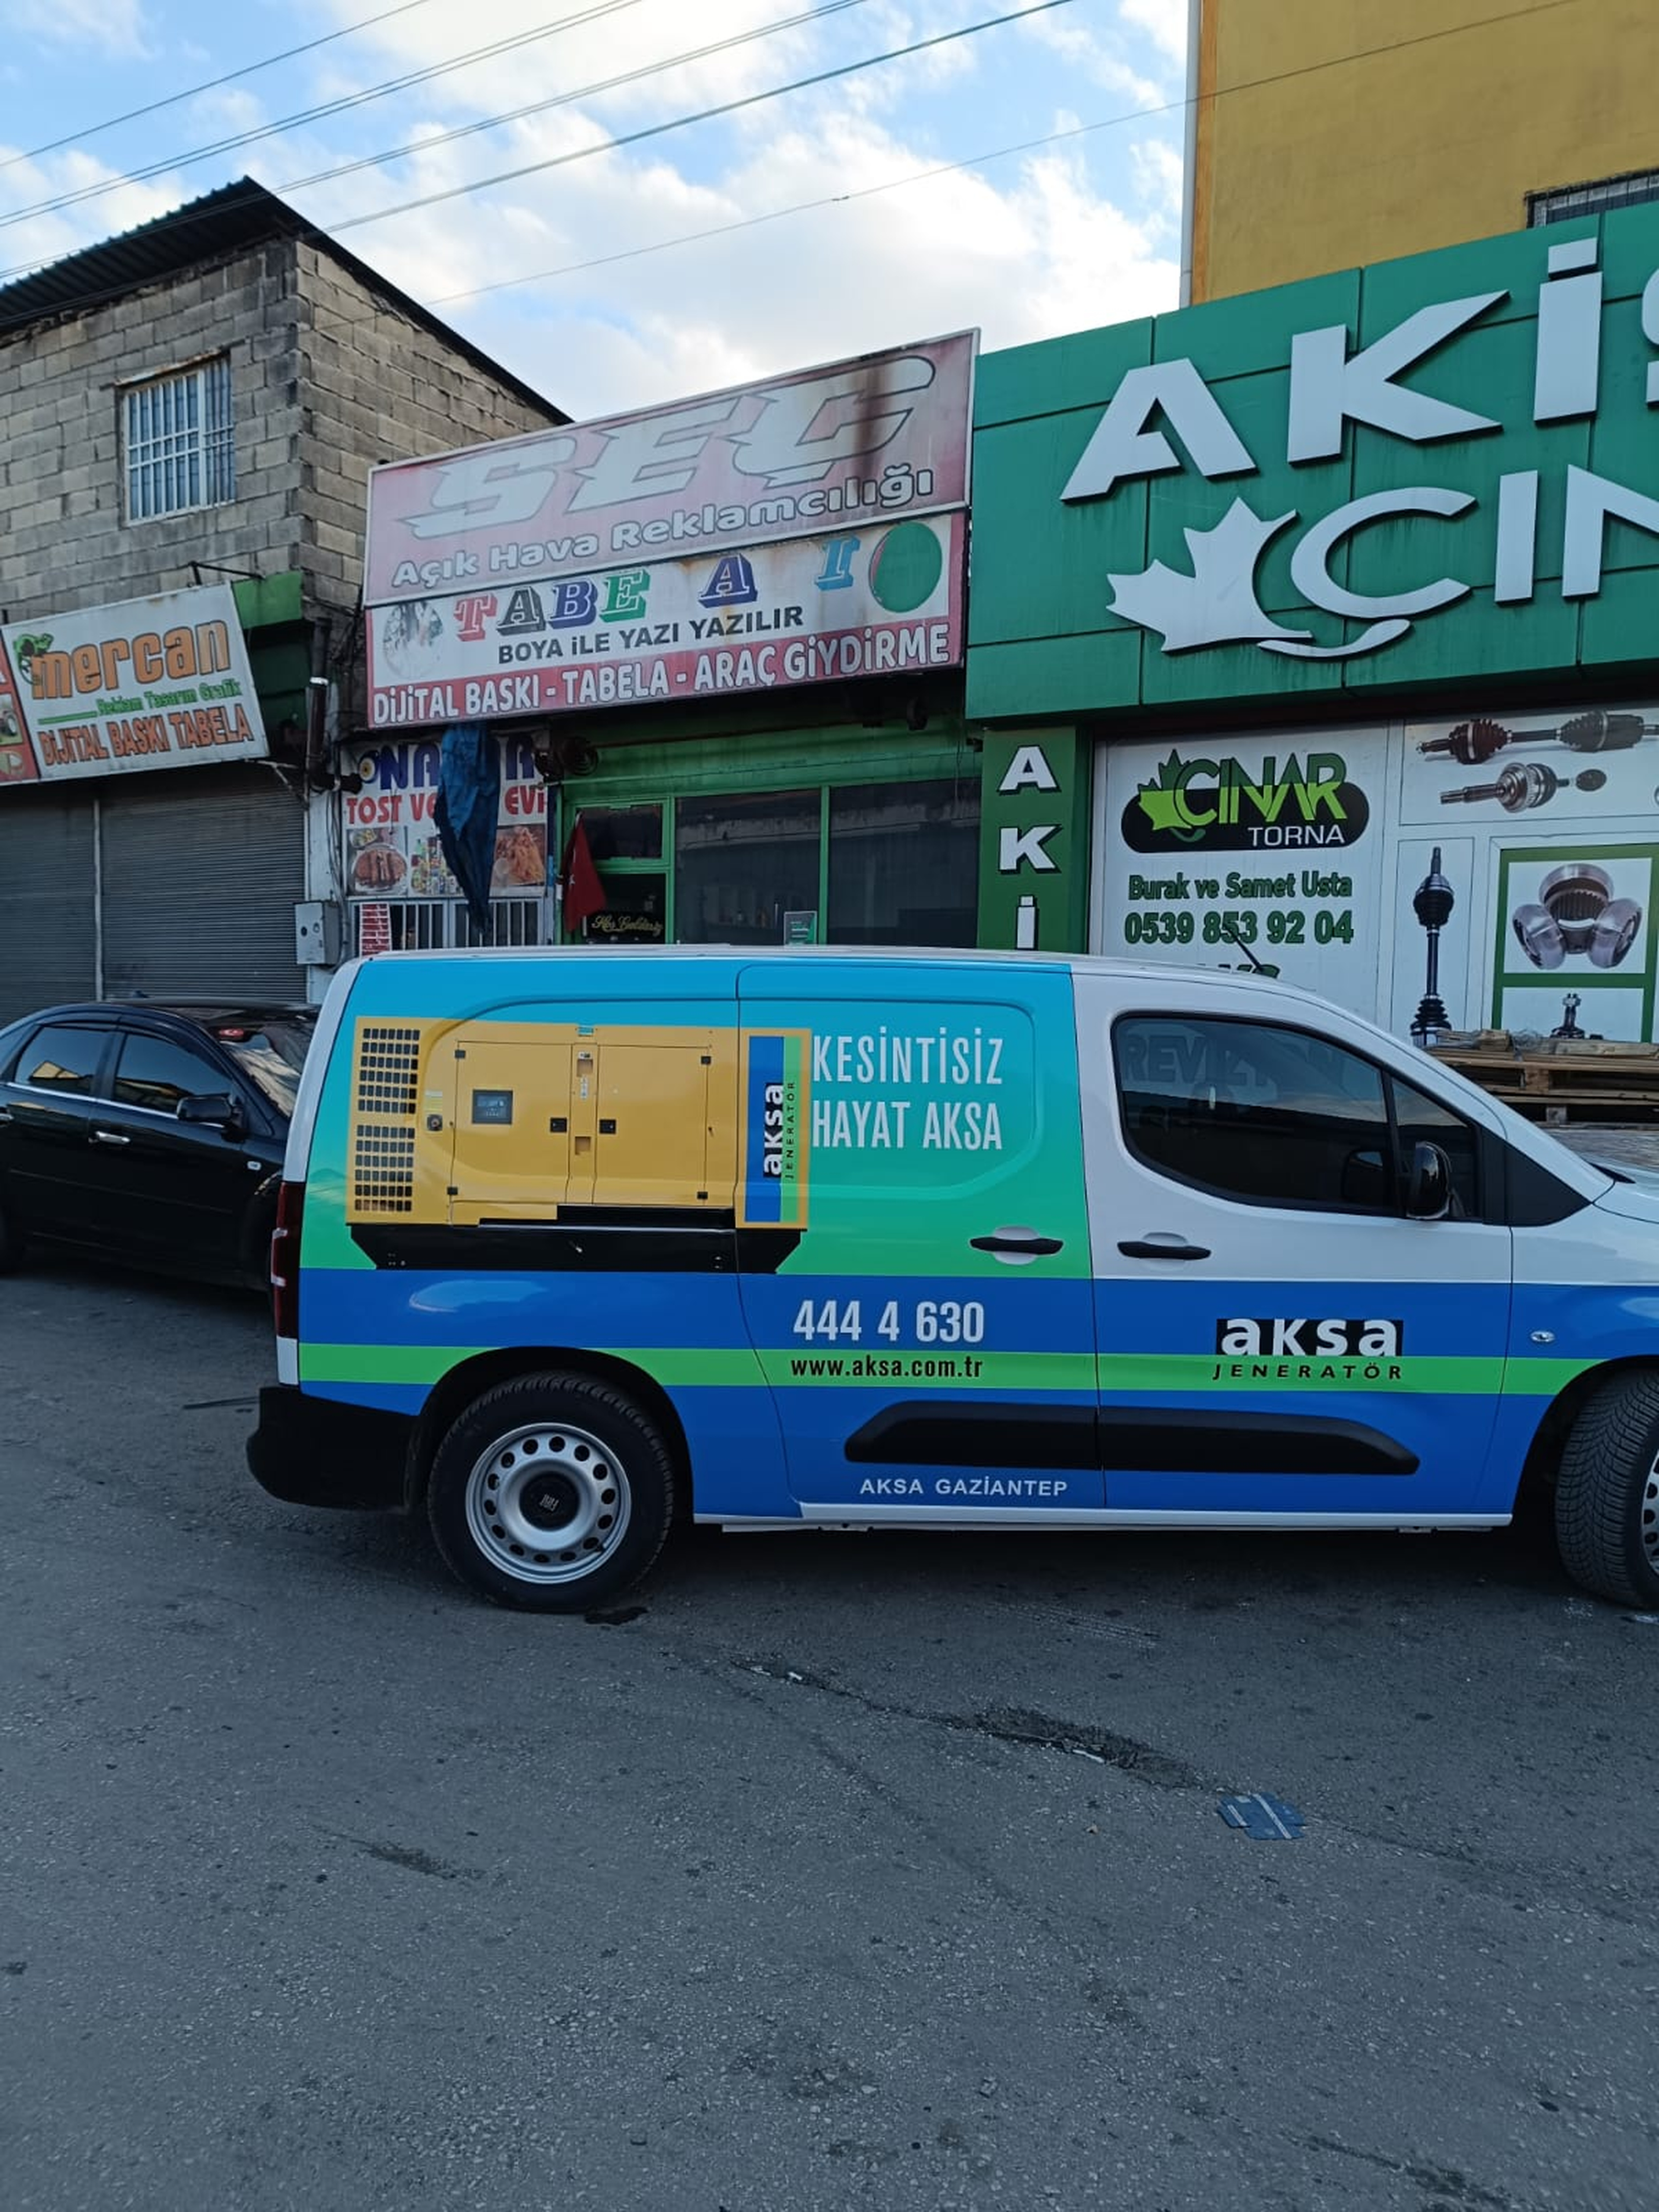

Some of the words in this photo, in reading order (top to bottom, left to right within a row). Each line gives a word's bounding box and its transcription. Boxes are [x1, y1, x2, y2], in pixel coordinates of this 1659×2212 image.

[1060, 237, 1659, 502] AKİ
[392, 551, 478, 588] Açık
[489, 534, 599, 572] Hava
[610, 463, 934, 550] Reklamcılığı
[499, 639, 563, 664] BOYA
[619, 623, 678, 649] YAZI
[689, 606, 803, 640] YAZILIR
[31, 620, 232, 699] mercan
[466, 674, 540, 714] BASKI
[562, 660, 669, 705] TABELA
[694, 646, 776, 691] ARAÇ
[106, 715, 171, 757] BASKI
[168, 703, 254, 750] TABELA
[347, 794, 402, 824] TOST
[1247, 825, 1345, 847] TORNA
[1128, 872, 1190, 900] Burak
[1195, 879, 1219, 899] ve
[1225, 872, 1296, 899] Samet
[1301, 871, 1352, 898] Usta
[1125, 911, 1195, 944] 0539
[1203, 910, 1258, 944] 853
[1267, 910, 1305, 944] 92
[1314, 909, 1354, 944] 04
[813, 1026, 1003, 1084] KESİNTİSİZ
[763, 1084, 783, 1175] aksa
[812, 1100, 910, 1149] HAYAT
[922, 1102, 1002, 1150] AKSA
[793, 1300, 862, 1341] 444
[877, 1300, 899, 1341] 4
[916, 1301, 985, 1343] 630
[1221, 1318, 1398, 1357] aksa
[791, 1354, 983, 1378] www.aksa.com.tr
[1213, 1362, 1401, 1380] JENERATÖR
[860, 1478, 924, 1494] AKSA
[935, 1476, 1068, 1496] GAZİANTEP
